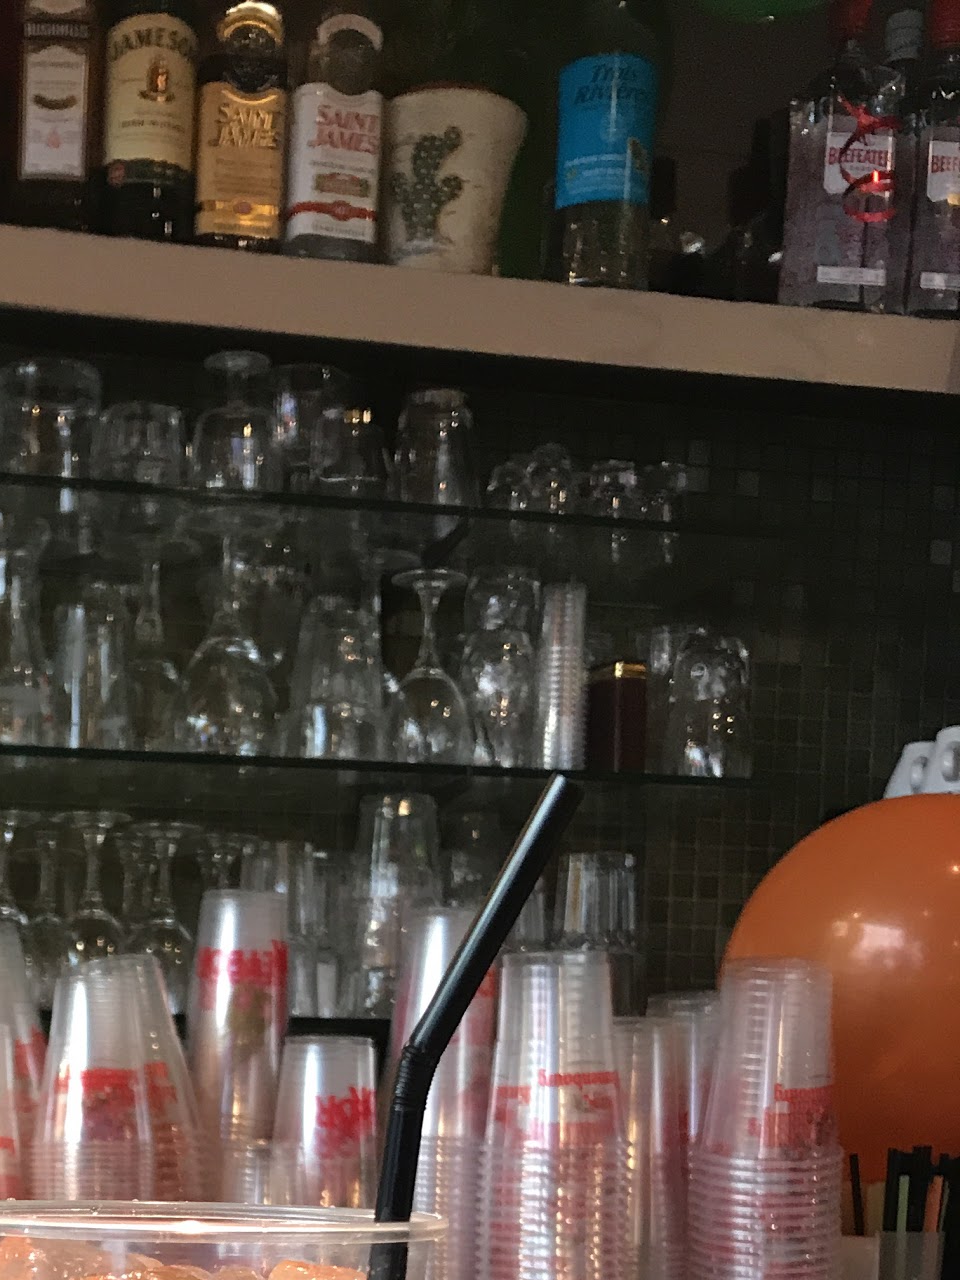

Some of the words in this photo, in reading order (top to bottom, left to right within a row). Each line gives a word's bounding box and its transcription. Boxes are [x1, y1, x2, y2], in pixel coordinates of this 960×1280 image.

[217, 103, 275, 130] SAINT
[315, 104, 379, 132] SAINT
[207, 124, 277, 150] JAMES
[308, 124, 378, 155] JAMES
[932, 156, 960, 174] BEEF
